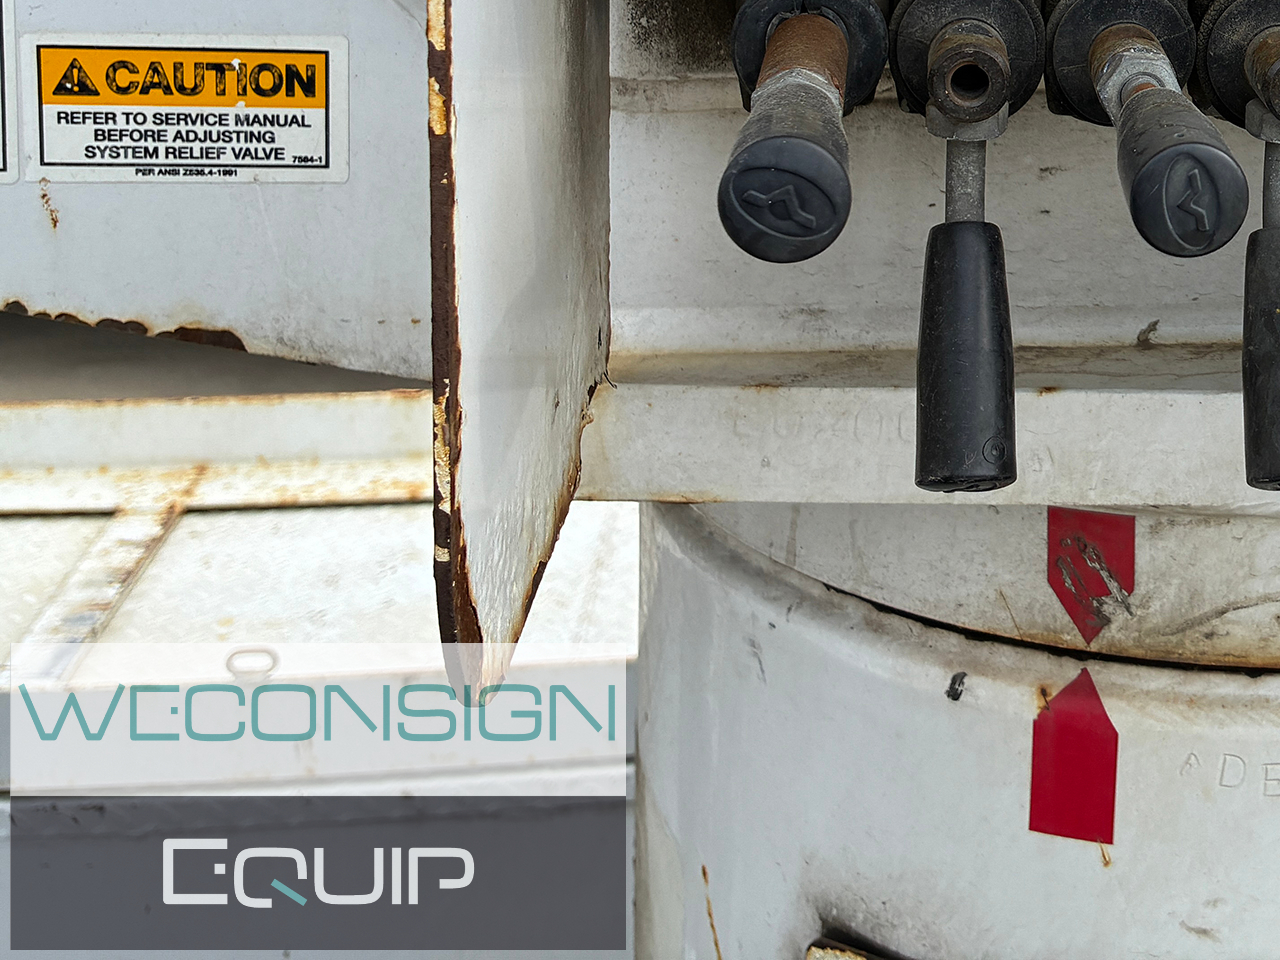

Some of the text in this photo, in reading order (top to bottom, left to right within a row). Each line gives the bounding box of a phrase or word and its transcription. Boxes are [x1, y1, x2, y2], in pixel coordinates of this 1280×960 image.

[106, 60, 316, 98] CAUTION
[57, 111, 311, 128] REFER TO SERVICE MANUAL
[94, 129, 275, 144] BEFORE ADJUSTING
[84, 145, 285, 161] SYSTEM RELIEF VALVE
[135, 168, 155, 176] PER
